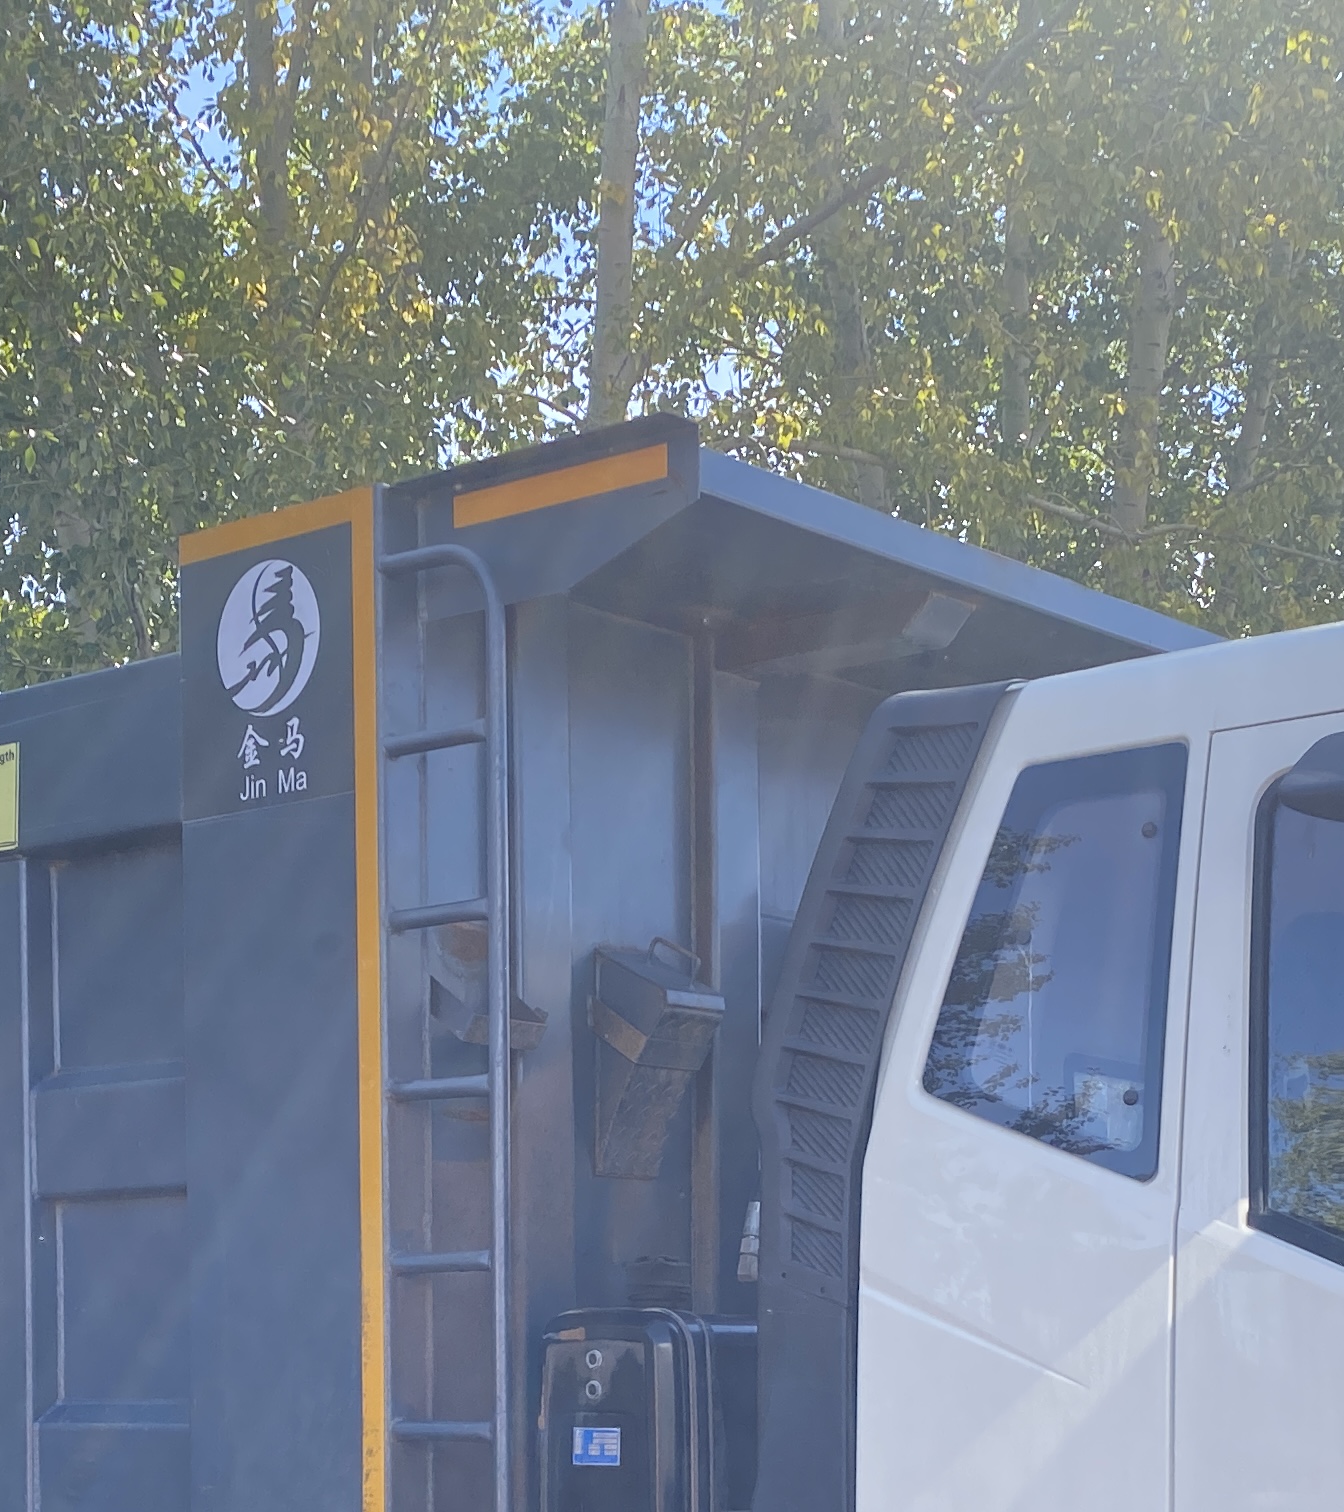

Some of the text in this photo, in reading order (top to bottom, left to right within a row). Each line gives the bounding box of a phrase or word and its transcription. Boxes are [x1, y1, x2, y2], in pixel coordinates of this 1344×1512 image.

[237, 716, 304, 769] 金马
[239, 766, 307, 801] Jin Ma
